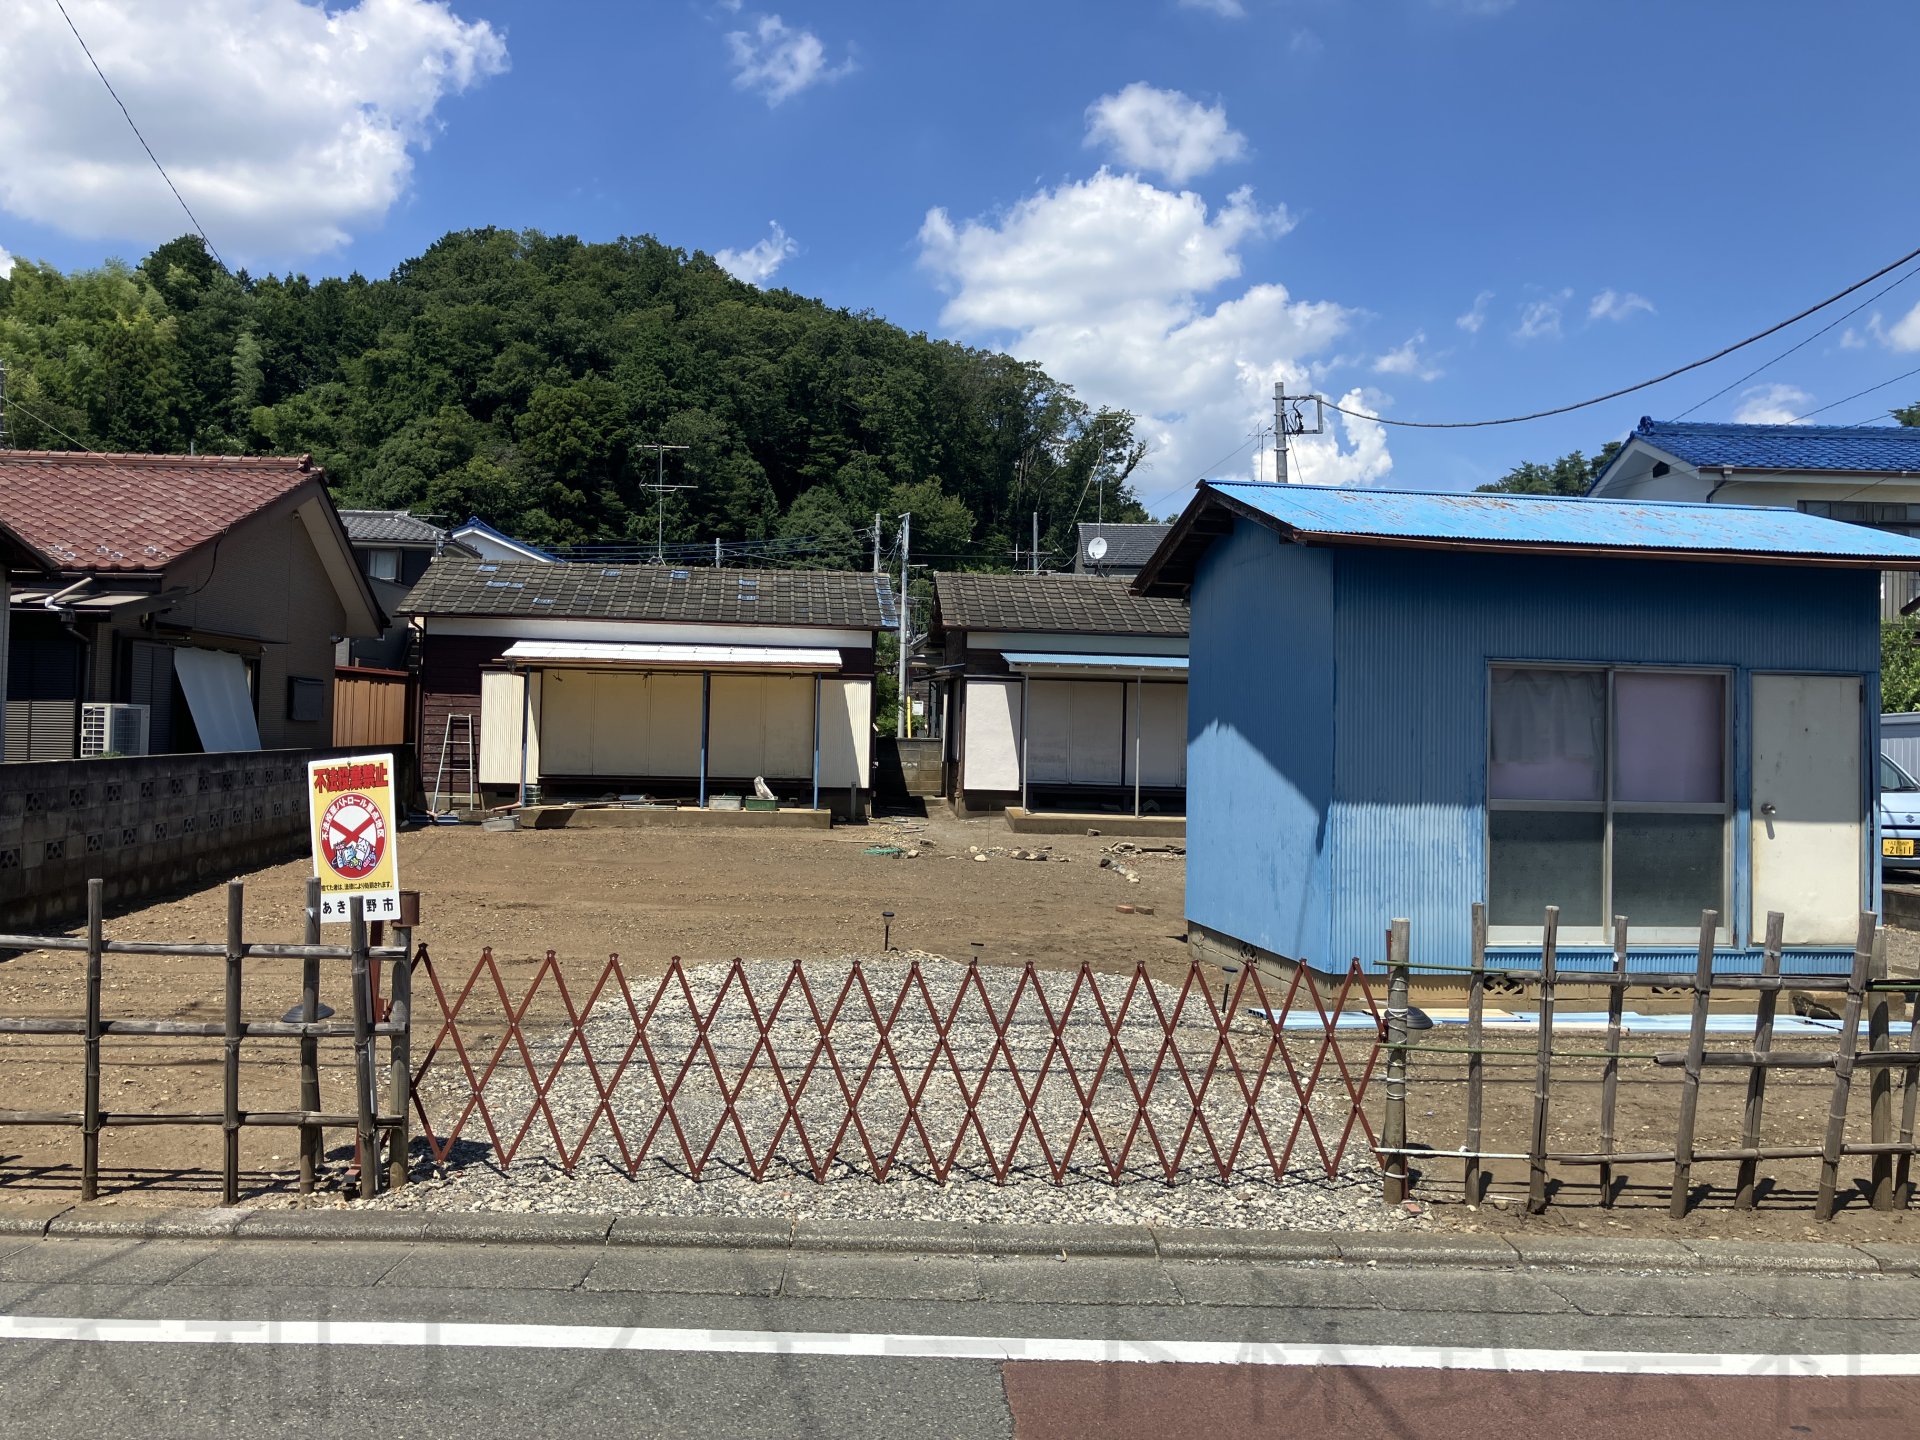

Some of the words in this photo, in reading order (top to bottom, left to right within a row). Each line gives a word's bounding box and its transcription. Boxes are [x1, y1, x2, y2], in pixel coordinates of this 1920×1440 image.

[314, 763, 388, 793] 不法投棄禁止
[323, 897, 394, 914] あき野市
